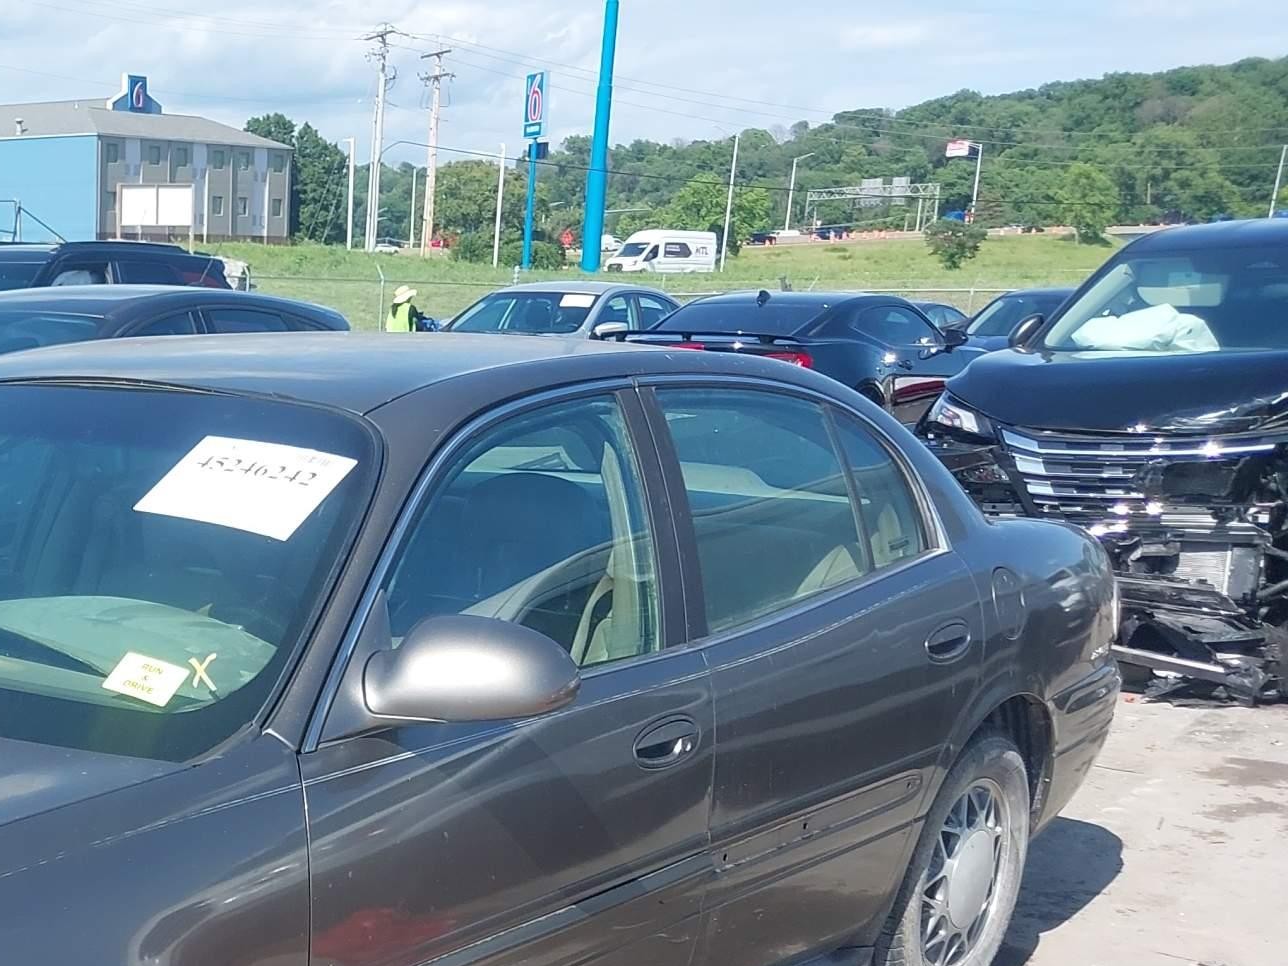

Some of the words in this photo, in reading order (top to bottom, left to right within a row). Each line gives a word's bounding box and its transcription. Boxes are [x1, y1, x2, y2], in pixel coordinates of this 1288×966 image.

[133, 81, 144, 108] 6
[527, 74, 542, 122] 6
[196, 455, 318, 487] 45246242
[141, 663, 165, 676] RUN
